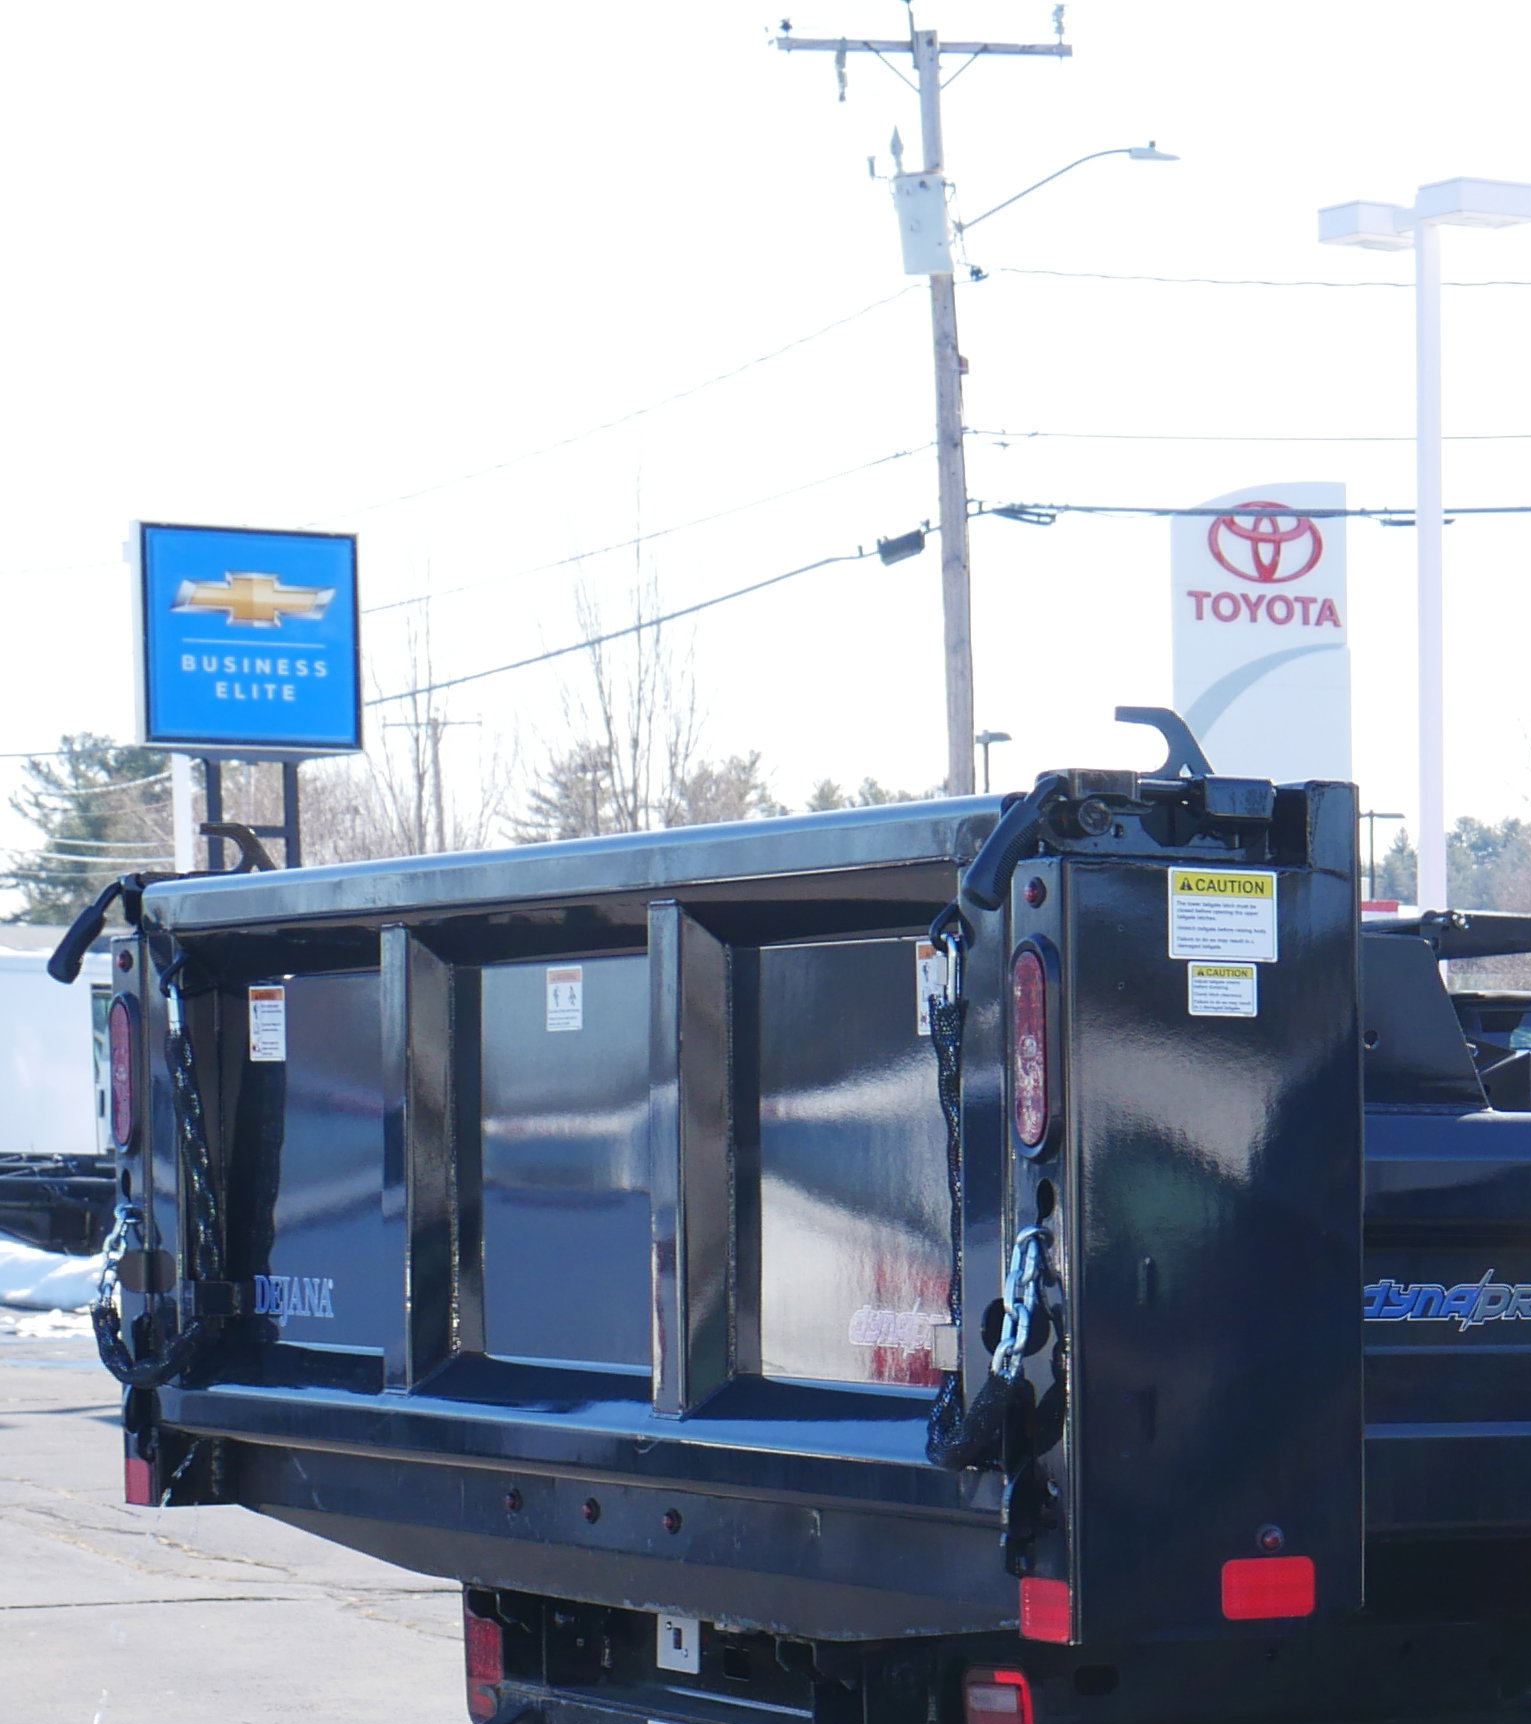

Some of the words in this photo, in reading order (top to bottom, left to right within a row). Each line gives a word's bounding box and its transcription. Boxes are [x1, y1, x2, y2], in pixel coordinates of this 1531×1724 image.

[1187, 590, 1342, 628] TOYOTA
[181, 654, 328, 677] BUSINESS
[215, 681, 296, 701] ELITE
[1195, 878, 1265, 895] CAUTION
[1206, 968, 1248, 977] CAUTION
[254, 1275, 334, 1327] DEJANA
